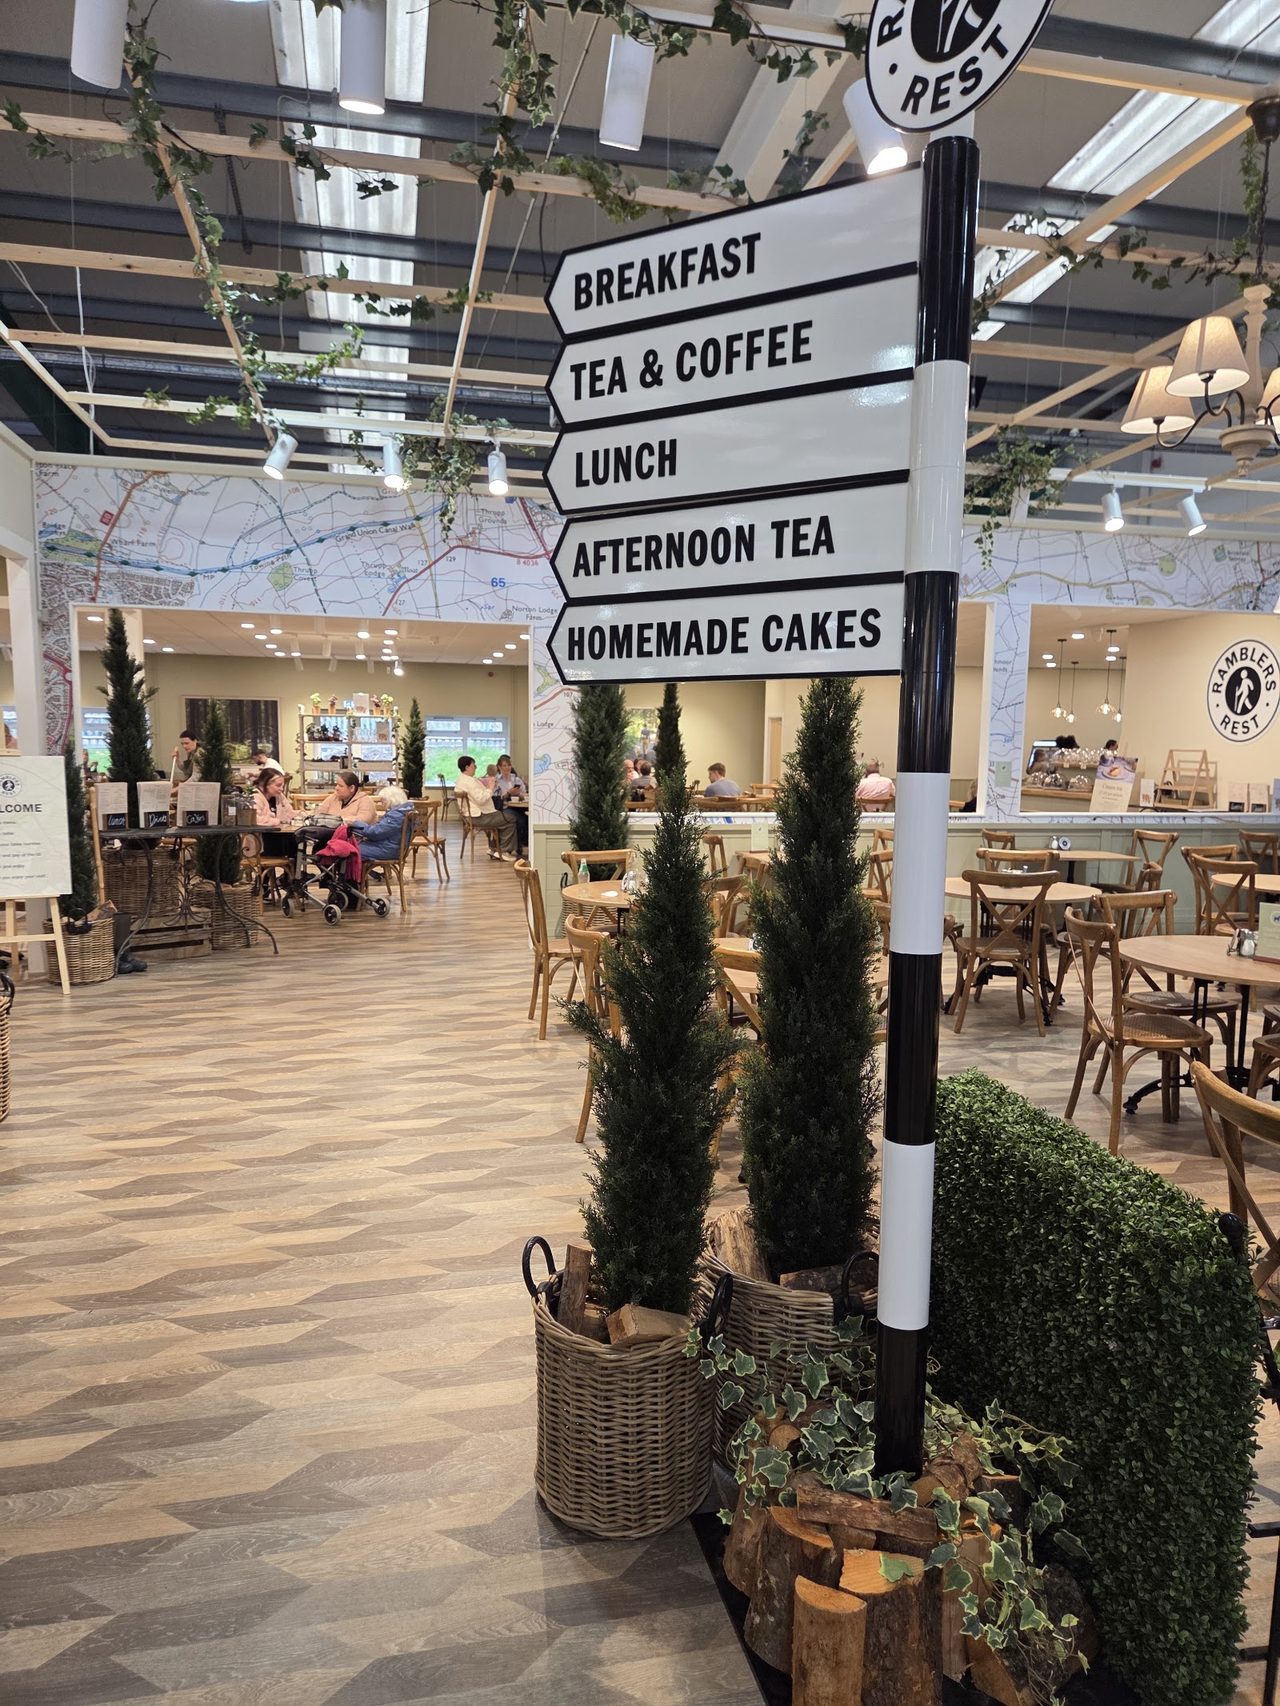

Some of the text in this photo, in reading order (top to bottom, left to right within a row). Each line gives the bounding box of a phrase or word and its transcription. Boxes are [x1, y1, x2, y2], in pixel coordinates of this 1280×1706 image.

[900, 23, 1009, 116] REST
[574, 233, 761, 310] BREAKFAST
[569, 320, 813, 401] TEA & COFFEE
[575, 439, 677, 488] LUNCH
[335, 532, 356, 543] Grand
[356, 529, 378, 537] Union
[378, 526, 398, 534] Canal
[572, 516, 835, 578] AFTERNOON TEA
[490, 577, 506, 588] 65
[512, 605, 558, 615] Norton Lodge
[567, 608, 881, 661] HOMEMADE CAKES
[1212, 646, 1277, 694] RAMBLERS
[1220, 714, 1260, 736] REST
